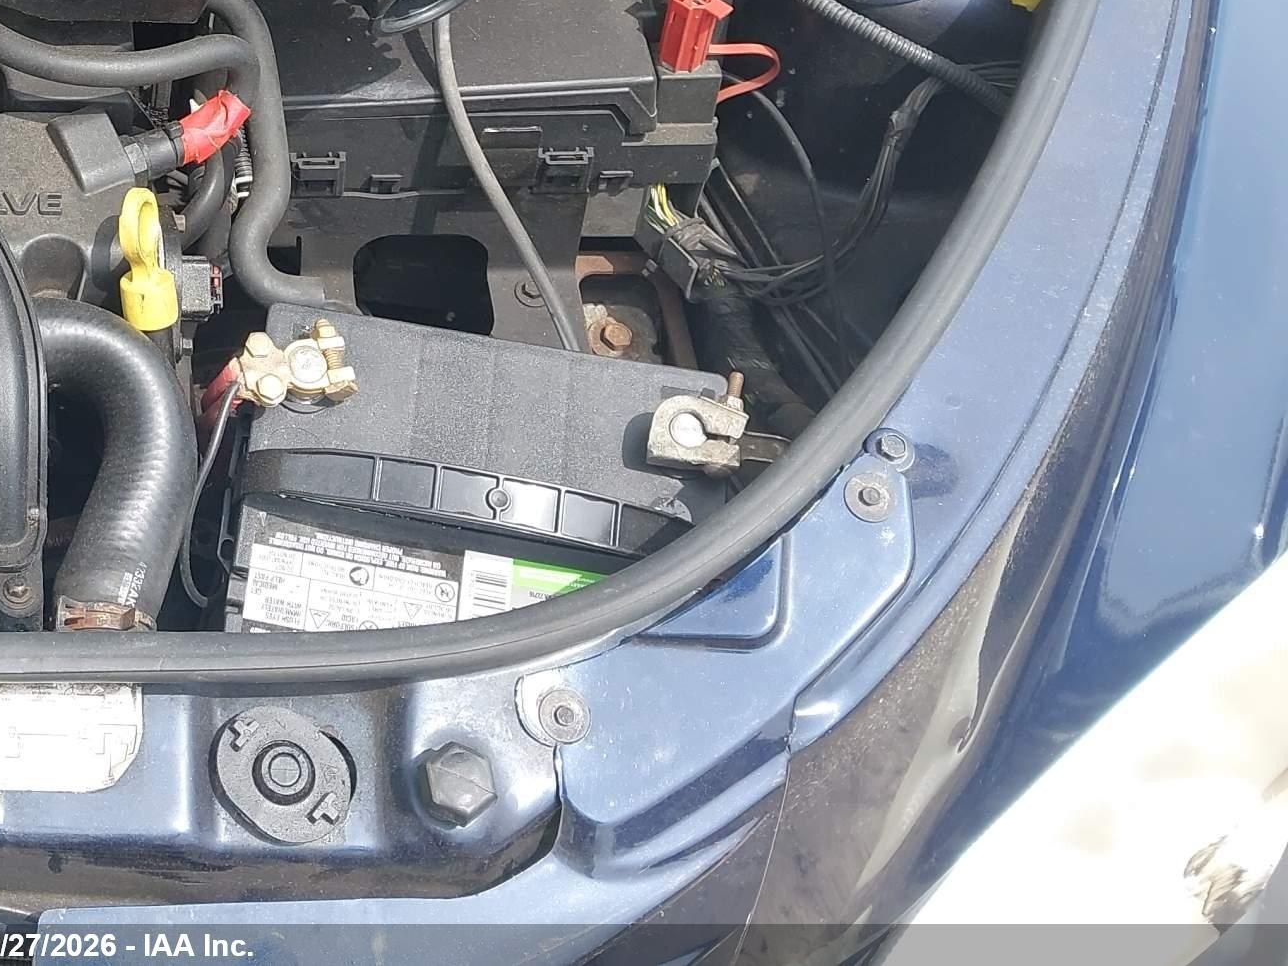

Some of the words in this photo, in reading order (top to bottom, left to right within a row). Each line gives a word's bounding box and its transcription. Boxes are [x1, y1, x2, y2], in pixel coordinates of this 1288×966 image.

[253, 571, 269, 580] FAST
[270, 575, 285, 583] HELP
[251, 579, 278, 589] MEDICAL
[264, 596, 284, 605] WATER
[286, 600, 301, 608] WITH
[260, 603, 301, 617] IMMEDIATELY
[264, 611, 279, 621] EYES
[281, 615, 299, 625] FLUSH
